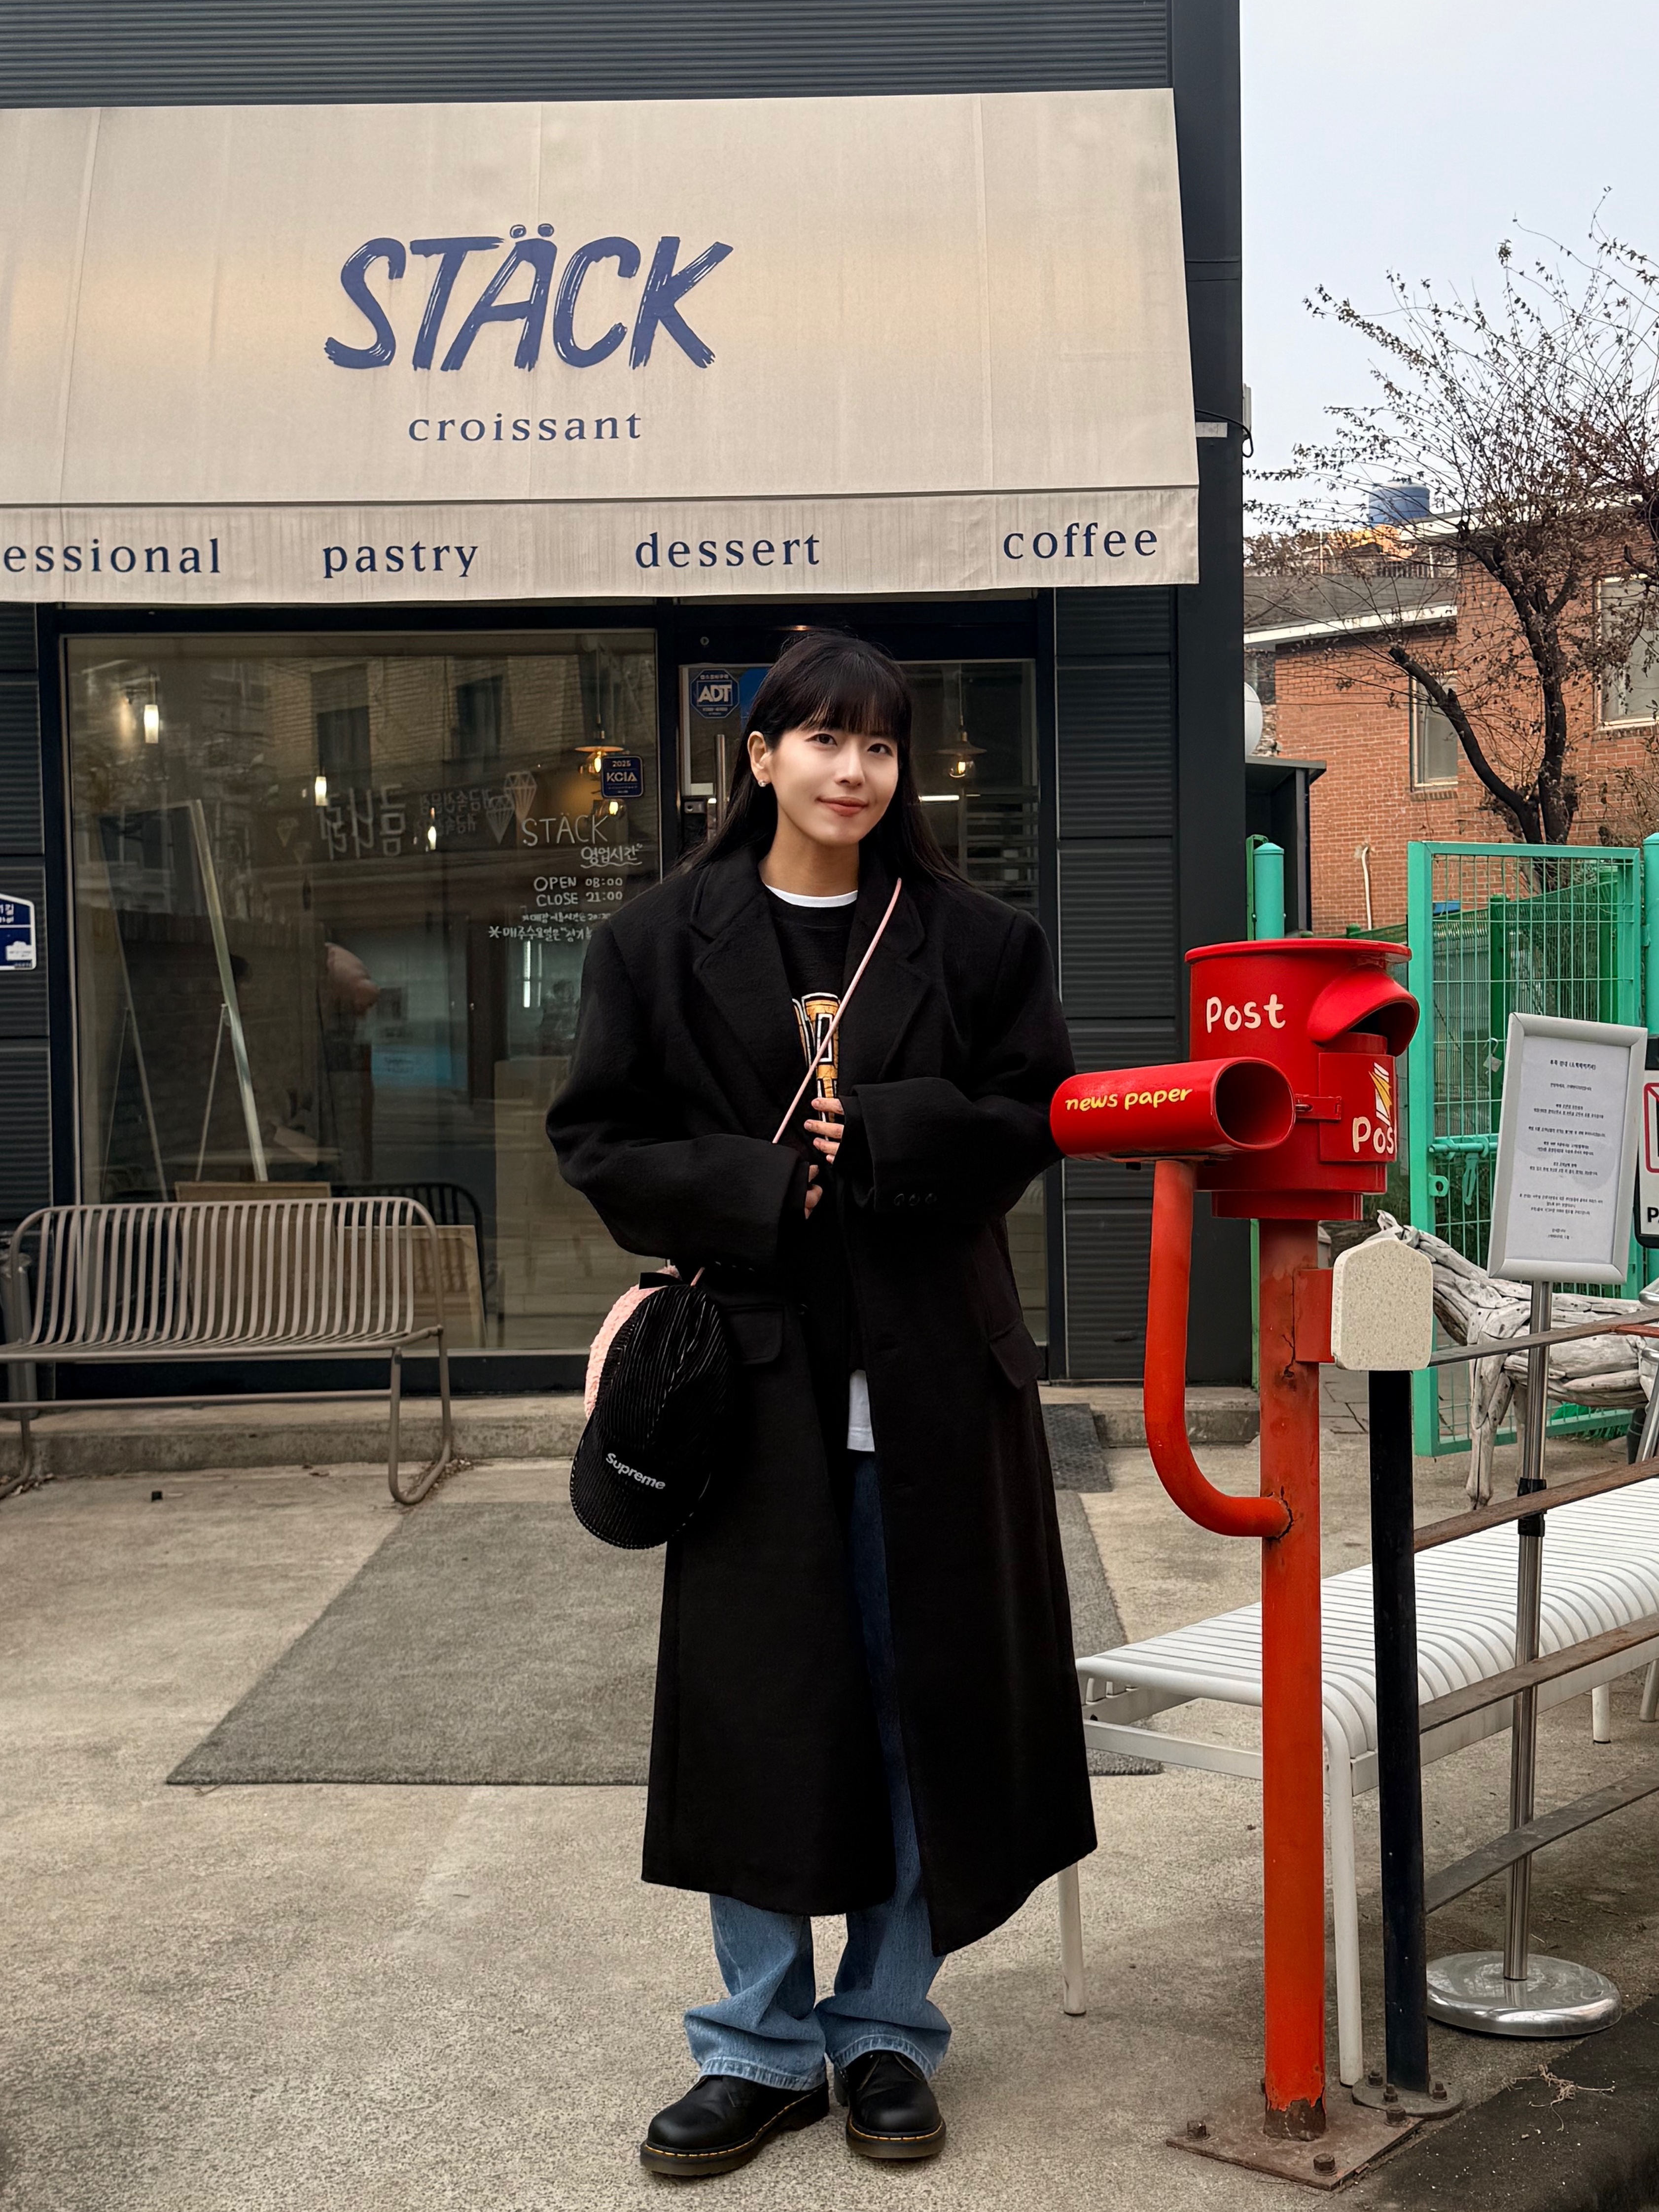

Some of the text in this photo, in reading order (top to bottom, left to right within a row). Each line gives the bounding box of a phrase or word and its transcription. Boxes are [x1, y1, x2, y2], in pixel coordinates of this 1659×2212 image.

[408, 413, 641, 441] croissant
[3, 522, 1158, 578] essional pastry dessert coffee
[697, 684, 732, 703] ADT
[606, 771, 637, 783] KCIA
[533, 876, 623, 892] OPEN 08:00
[536, 891, 623, 907] CLOSE 21:00
[1206, 993, 1286, 1034] Post
[1065, 1087, 1193, 1111] news paper
[1352, 1116, 1397, 1154] Pos
[1647, 1207, 1659, 1223] P
[605, 1453, 666, 1490] Supreme
